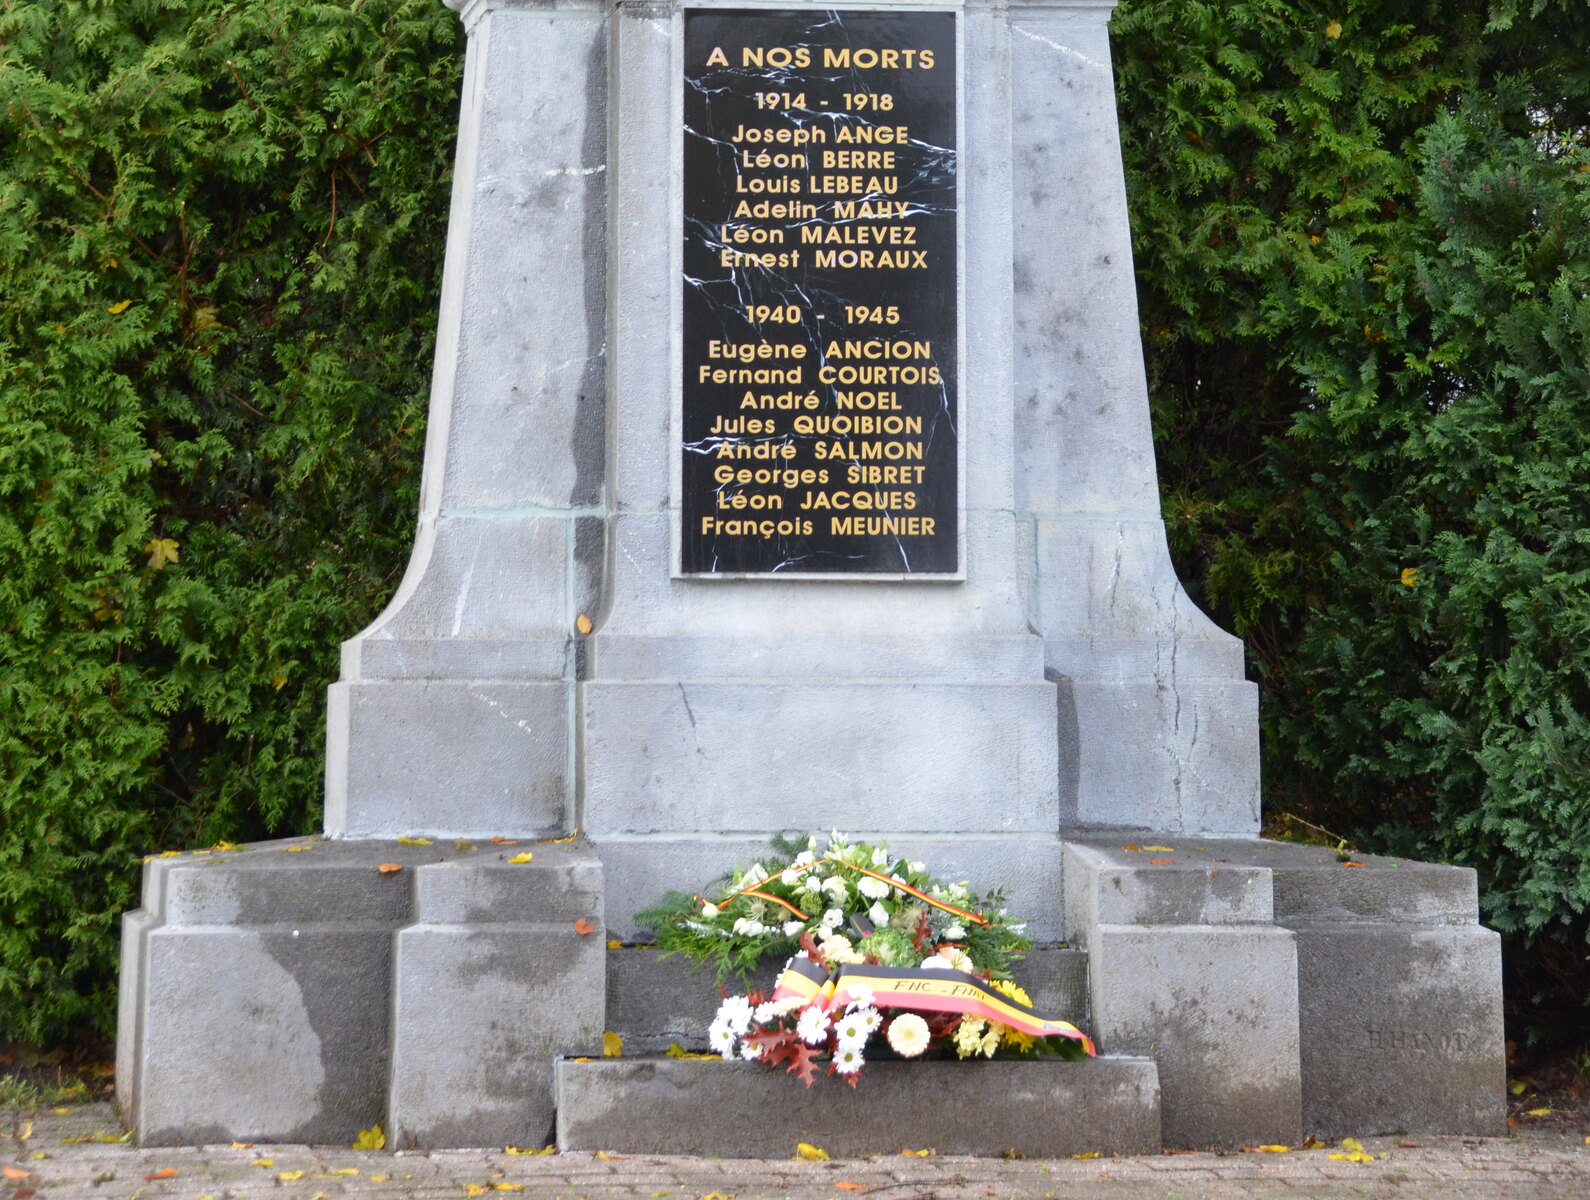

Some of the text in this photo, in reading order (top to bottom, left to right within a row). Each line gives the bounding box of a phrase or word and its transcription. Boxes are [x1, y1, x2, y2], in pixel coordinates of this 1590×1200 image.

[706, 47, 935, 69] A NOS MORTS
[756, 92, 807, 110] 1914
[843, 93, 894, 111] 1918
[732, 125, 908, 146] Joseph ANGE
[743, 149, 895, 169] Léon BERRE
[737, 176, 898, 194] Louis LEBEAU
[735, 200, 909, 218] Adelin MAHY
[722, 224, 917, 244] Léon MALEVEZ
[721, 250, 928, 268] Ernest MORAUX
[746, 305, 801, 323] 1940
[845, 306, 900, 324] 1945
[709, 340, 931, 363] Eugène ANCION
[699, 365, 940, 384] Fernand COURTOIS
[740, 390, 903, 410] André NOEL
[711, 415, 922, 434] Jules QUOIBION
[717, 439, 923, 460] André SALMON
[714, 465, 926, 488] Georges SIBRET
[719, 490, 917, 509] Léon JACQUES
[702, 516, 936, 539] François MEUNIER
